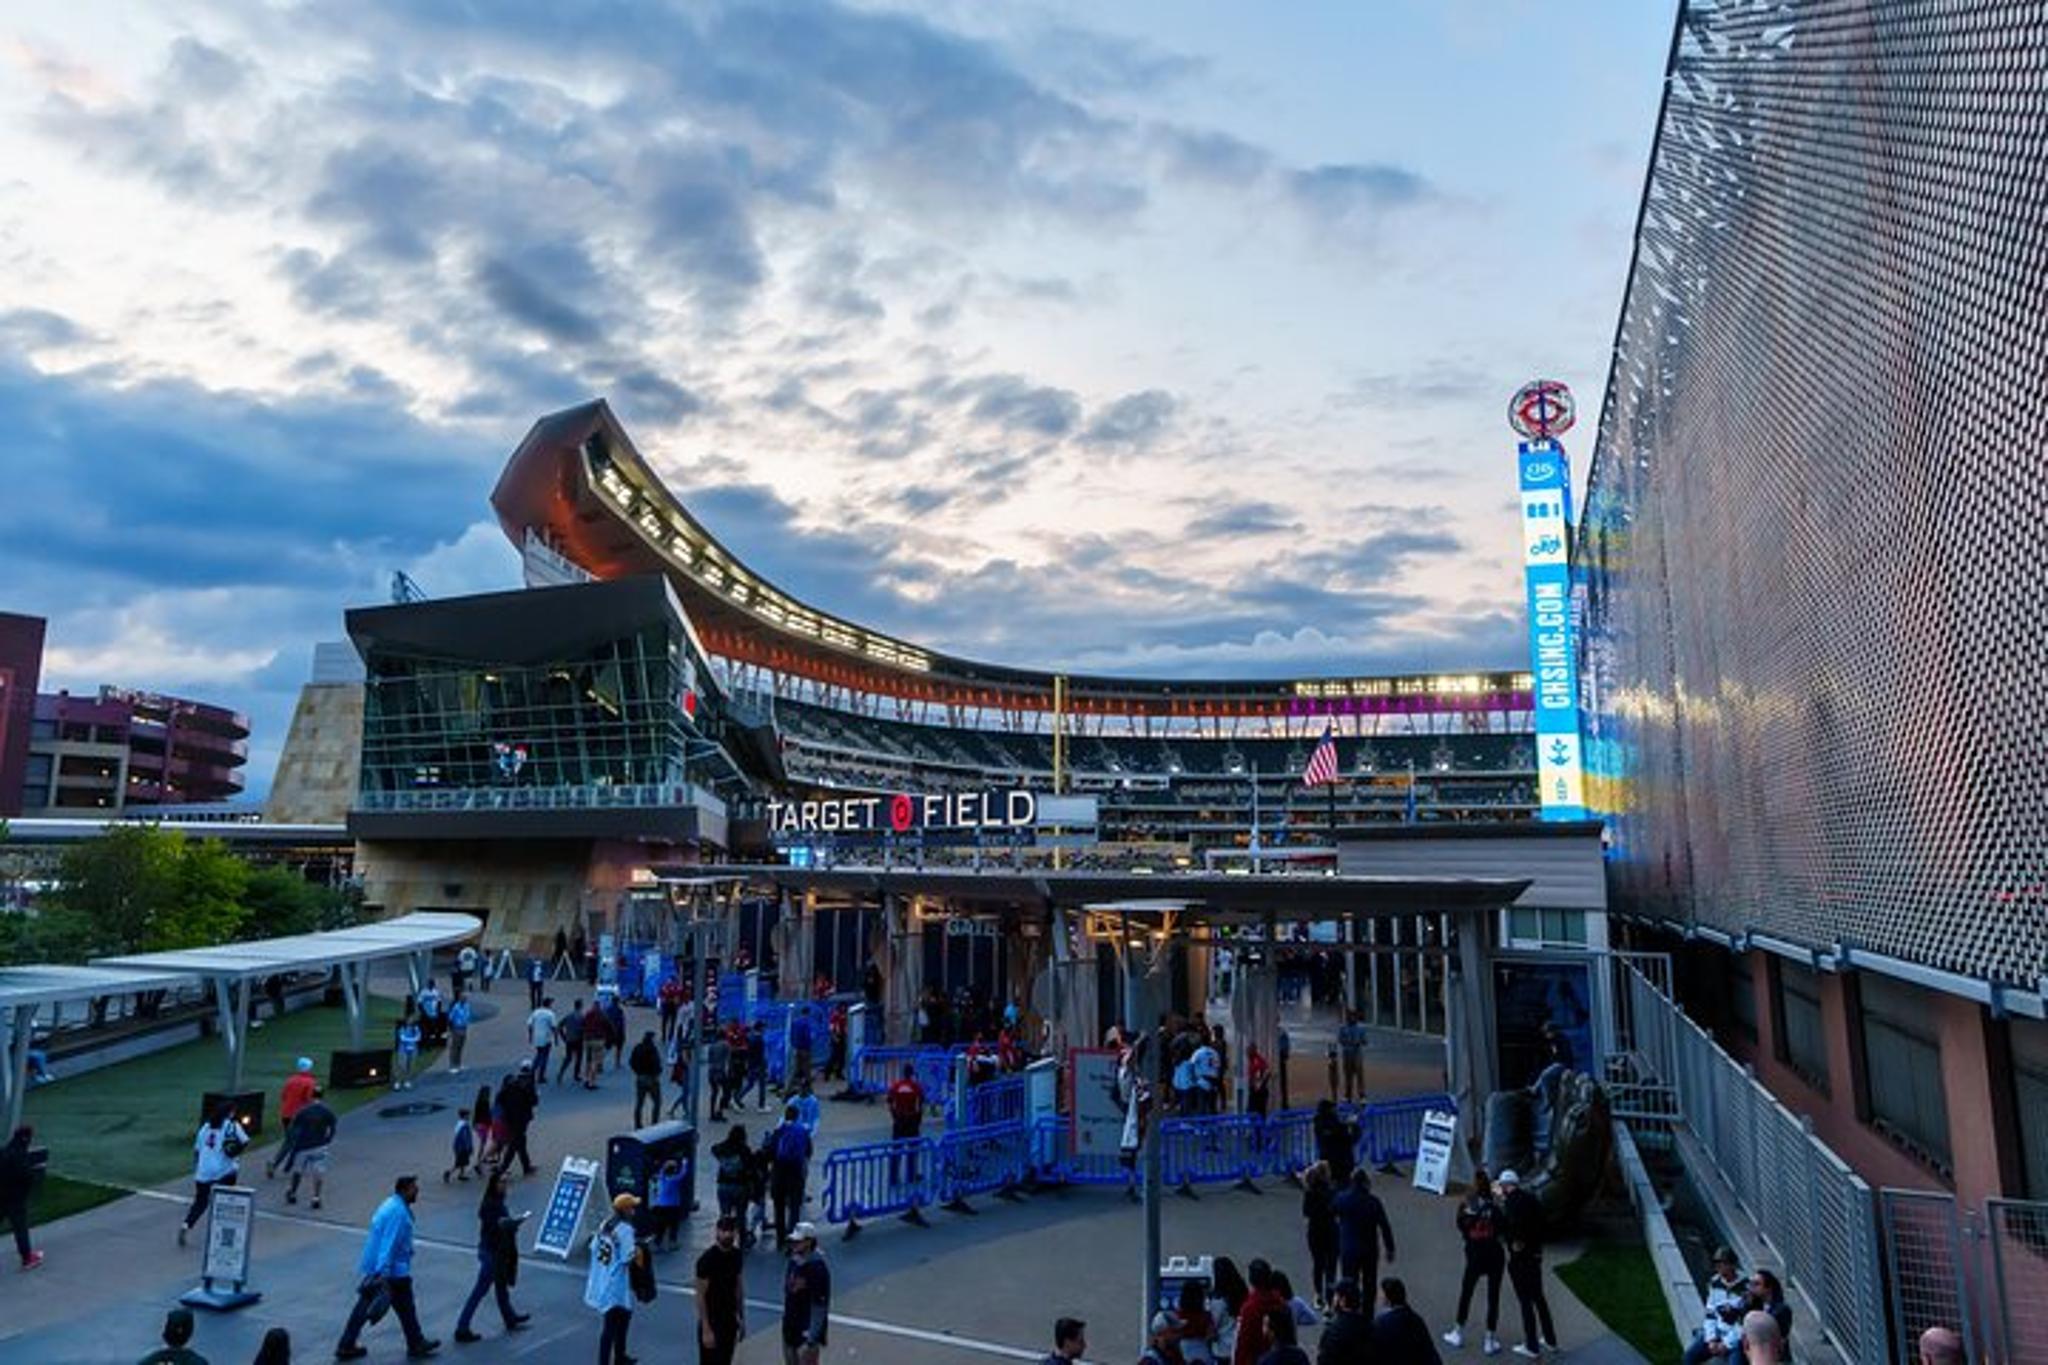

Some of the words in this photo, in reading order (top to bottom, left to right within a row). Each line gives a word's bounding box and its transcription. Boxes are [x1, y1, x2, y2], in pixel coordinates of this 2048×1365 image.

[1535, 581, 1571, 709] CHSINC.COM
[767, 798, 880, 831] TARGET
[923, 790, 1034, 828] FIELD
